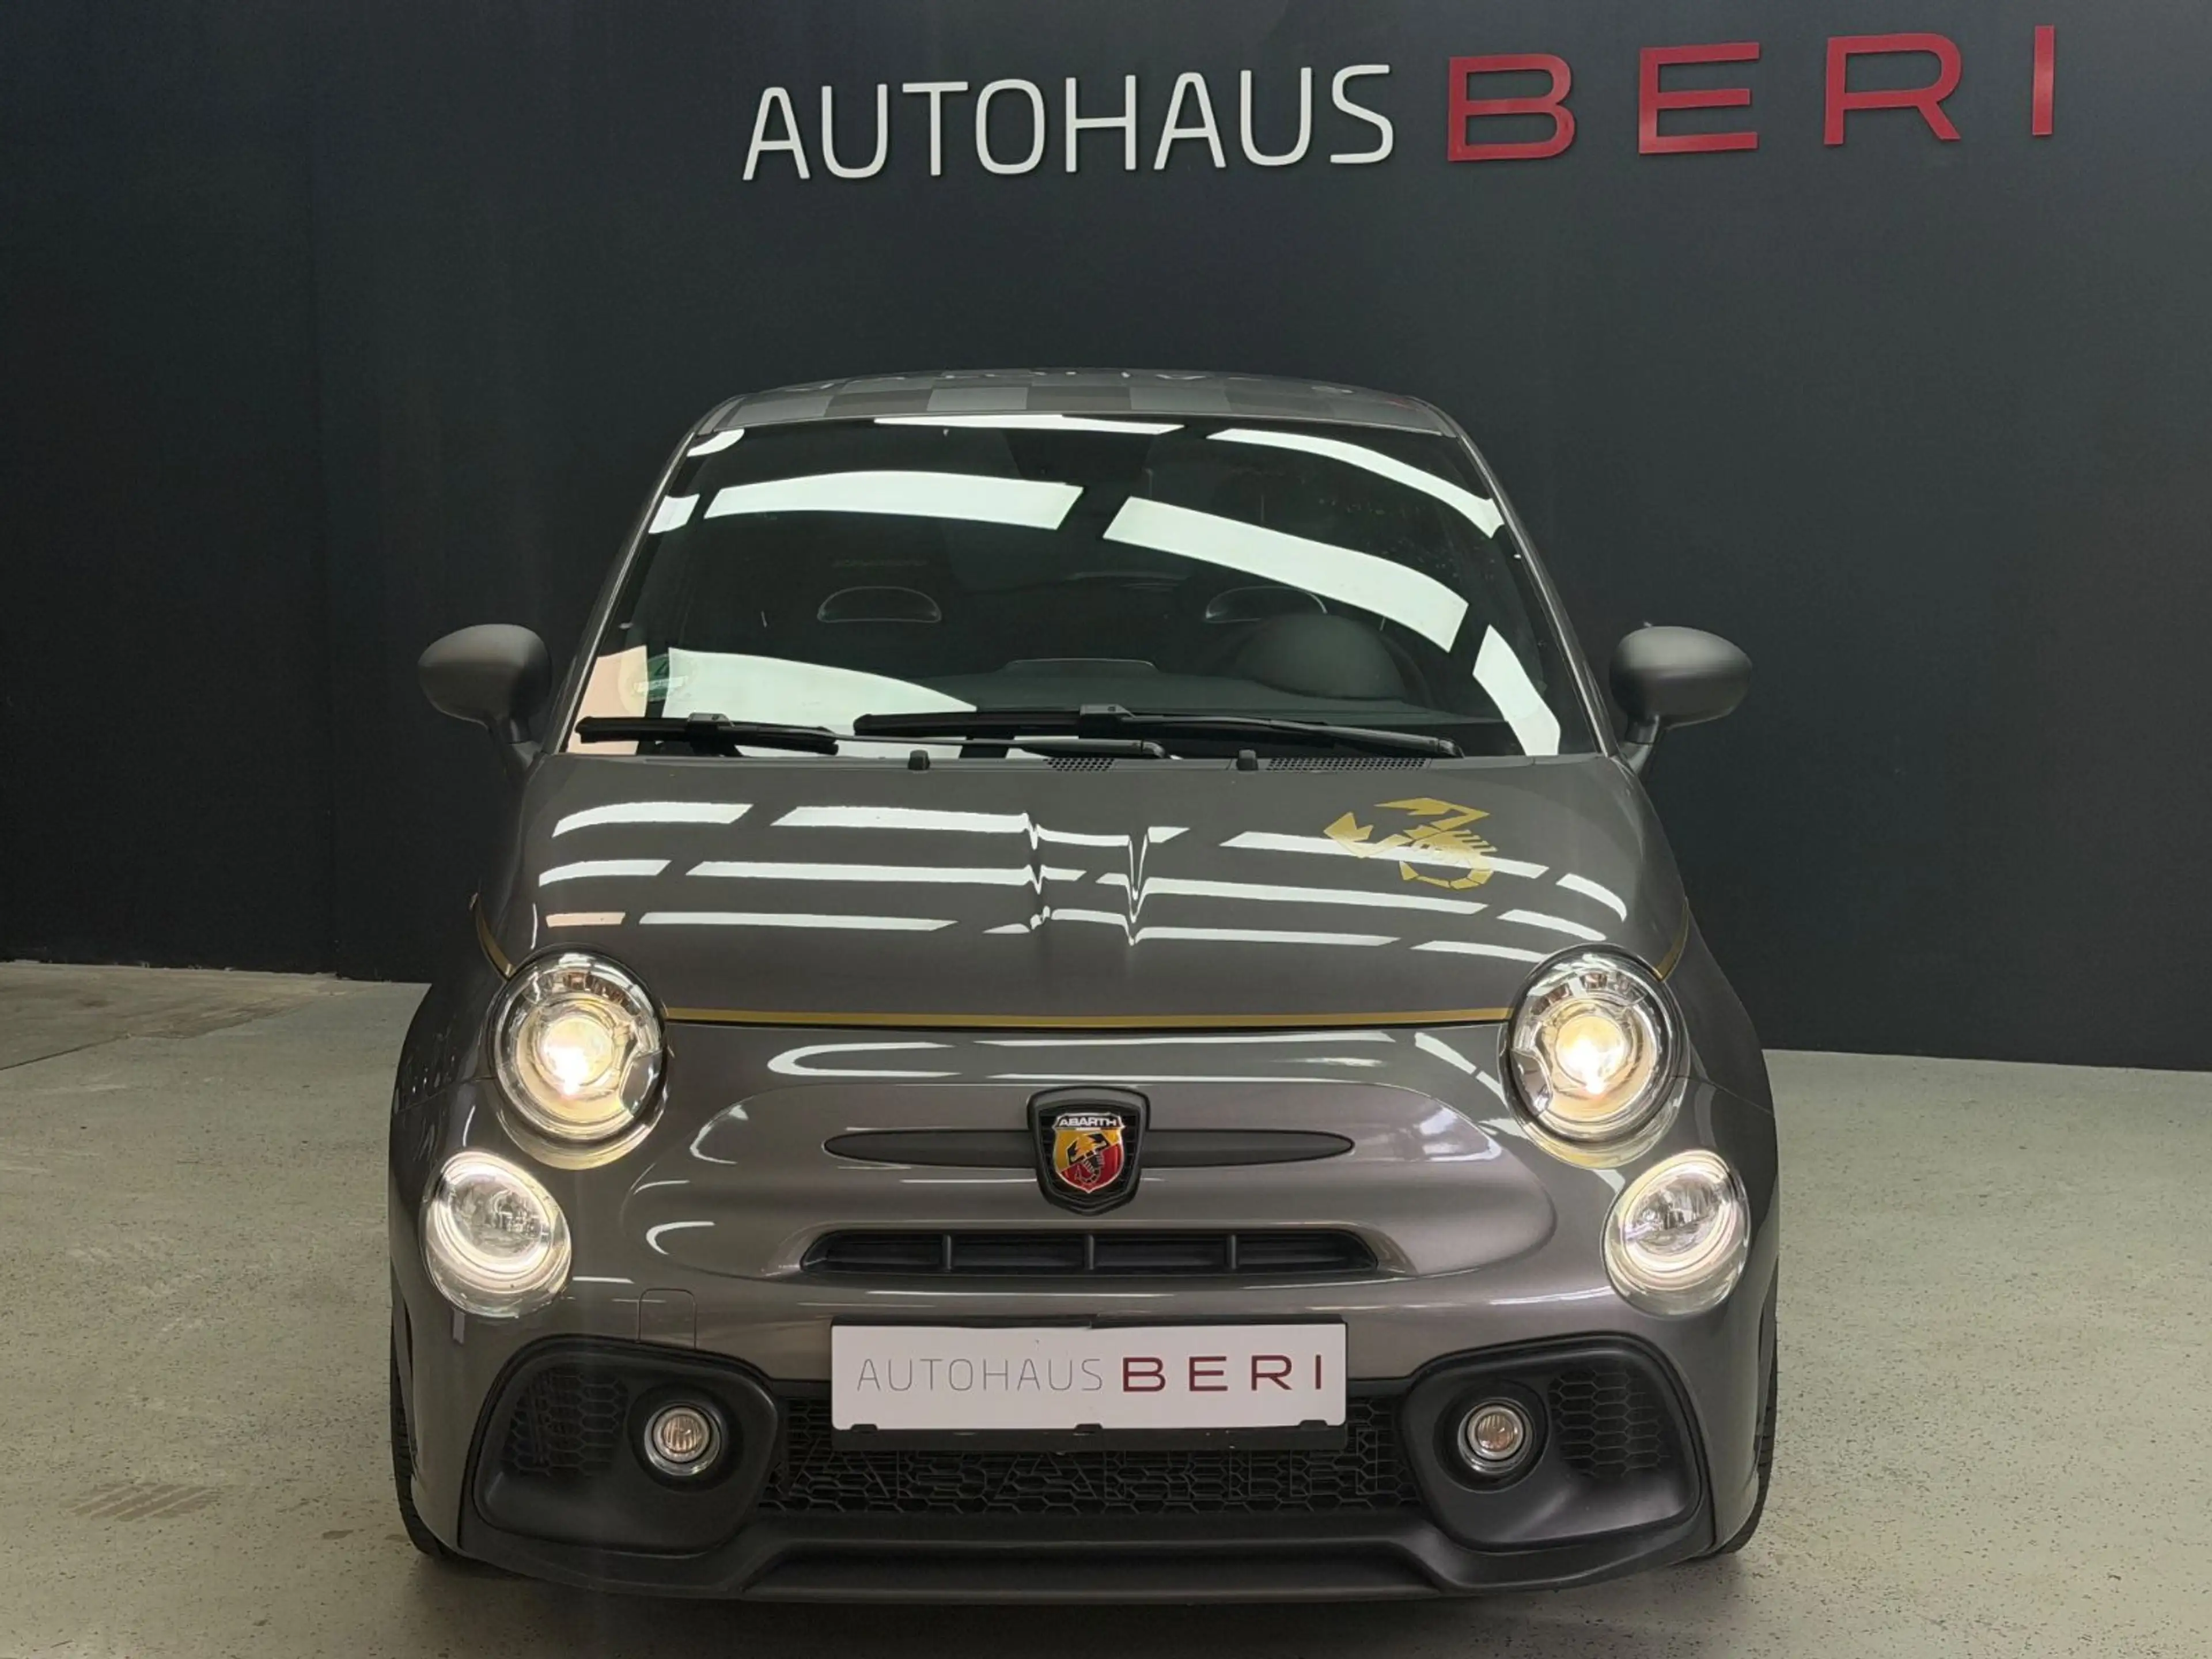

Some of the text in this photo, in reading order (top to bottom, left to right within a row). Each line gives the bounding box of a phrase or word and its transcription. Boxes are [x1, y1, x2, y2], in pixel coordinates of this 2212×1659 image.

[743, 24, 2057, 181] AUTOHAUS BERI
[1059, 1117, 1118, 1127] ABARTH
[856, 1354, 1322, 1392] AUTOHAUS BERI
